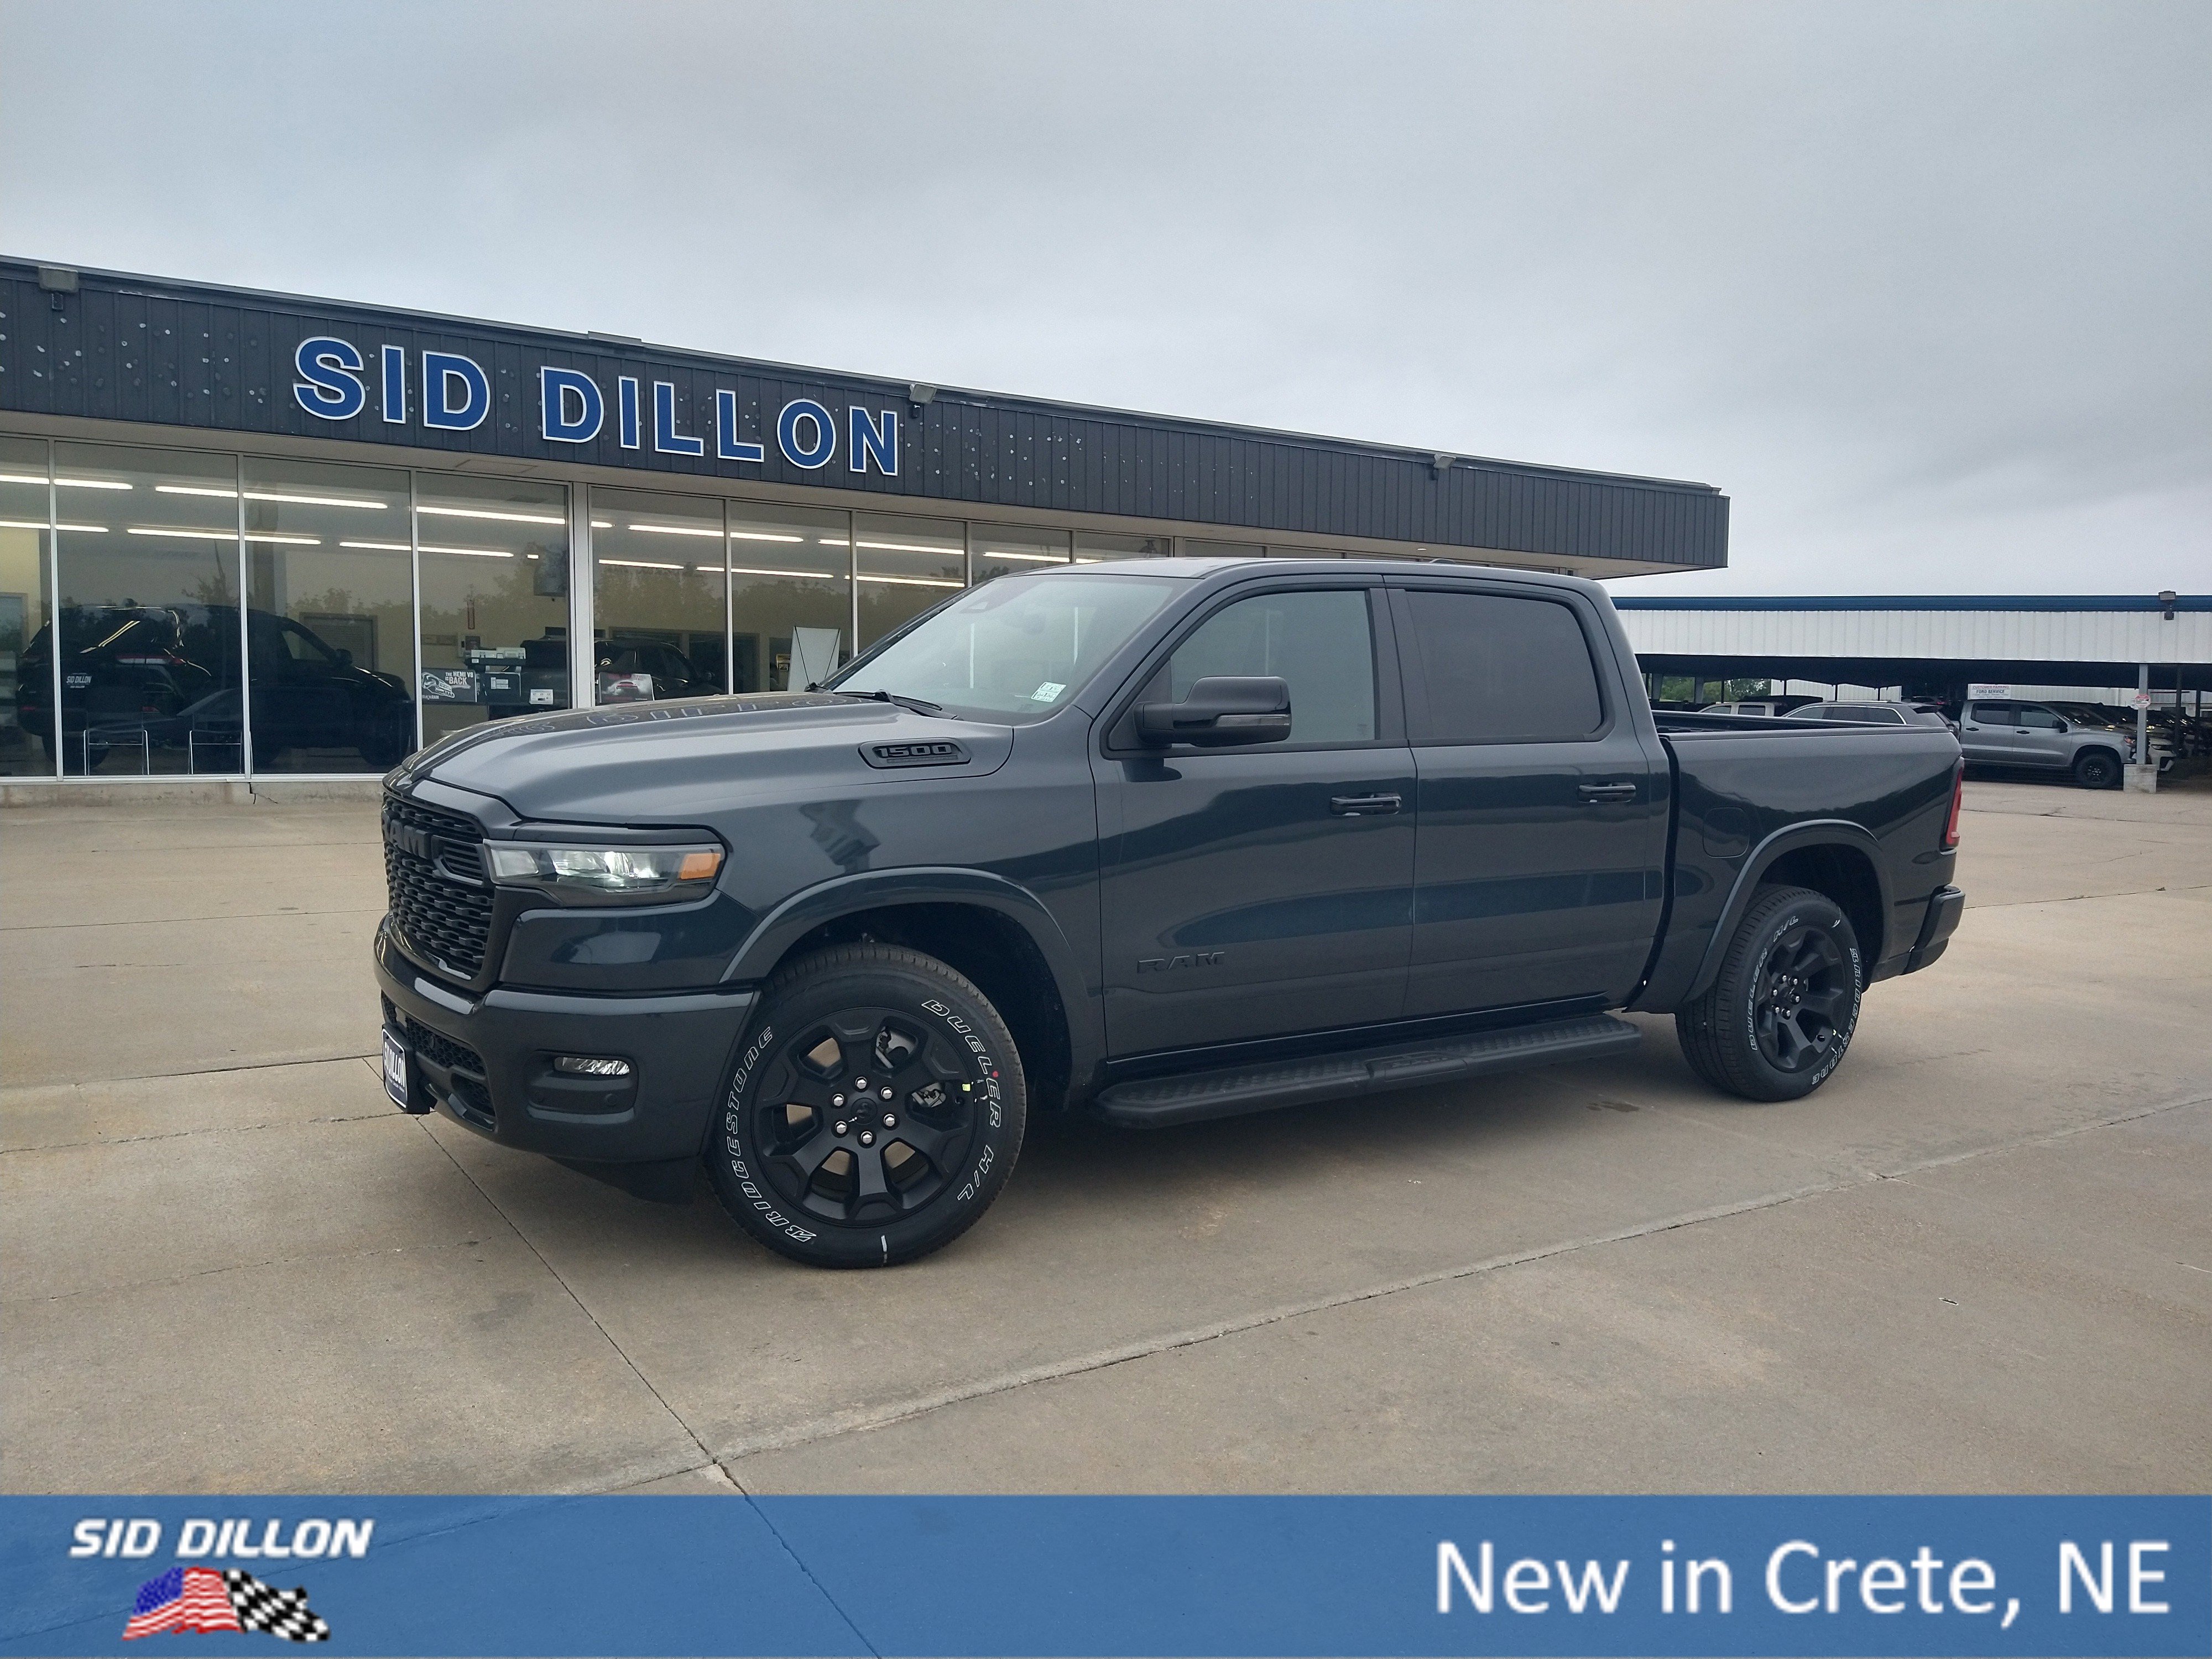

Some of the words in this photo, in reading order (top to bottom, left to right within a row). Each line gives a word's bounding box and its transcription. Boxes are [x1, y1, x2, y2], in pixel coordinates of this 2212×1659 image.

[293, 336, 491, 431] SID
[540, 366, 898, 476] DILLON
[449, 676, 467, 685] BACK
[877, 744, 953, 758] 1500
[382, 808, 429, 859] RAM
[1136, 951, 1225, 974] RAM
[921, 999, 1001, 1128] DUELER
[726, 1026, 817, 1243] BRIDGESTONE
